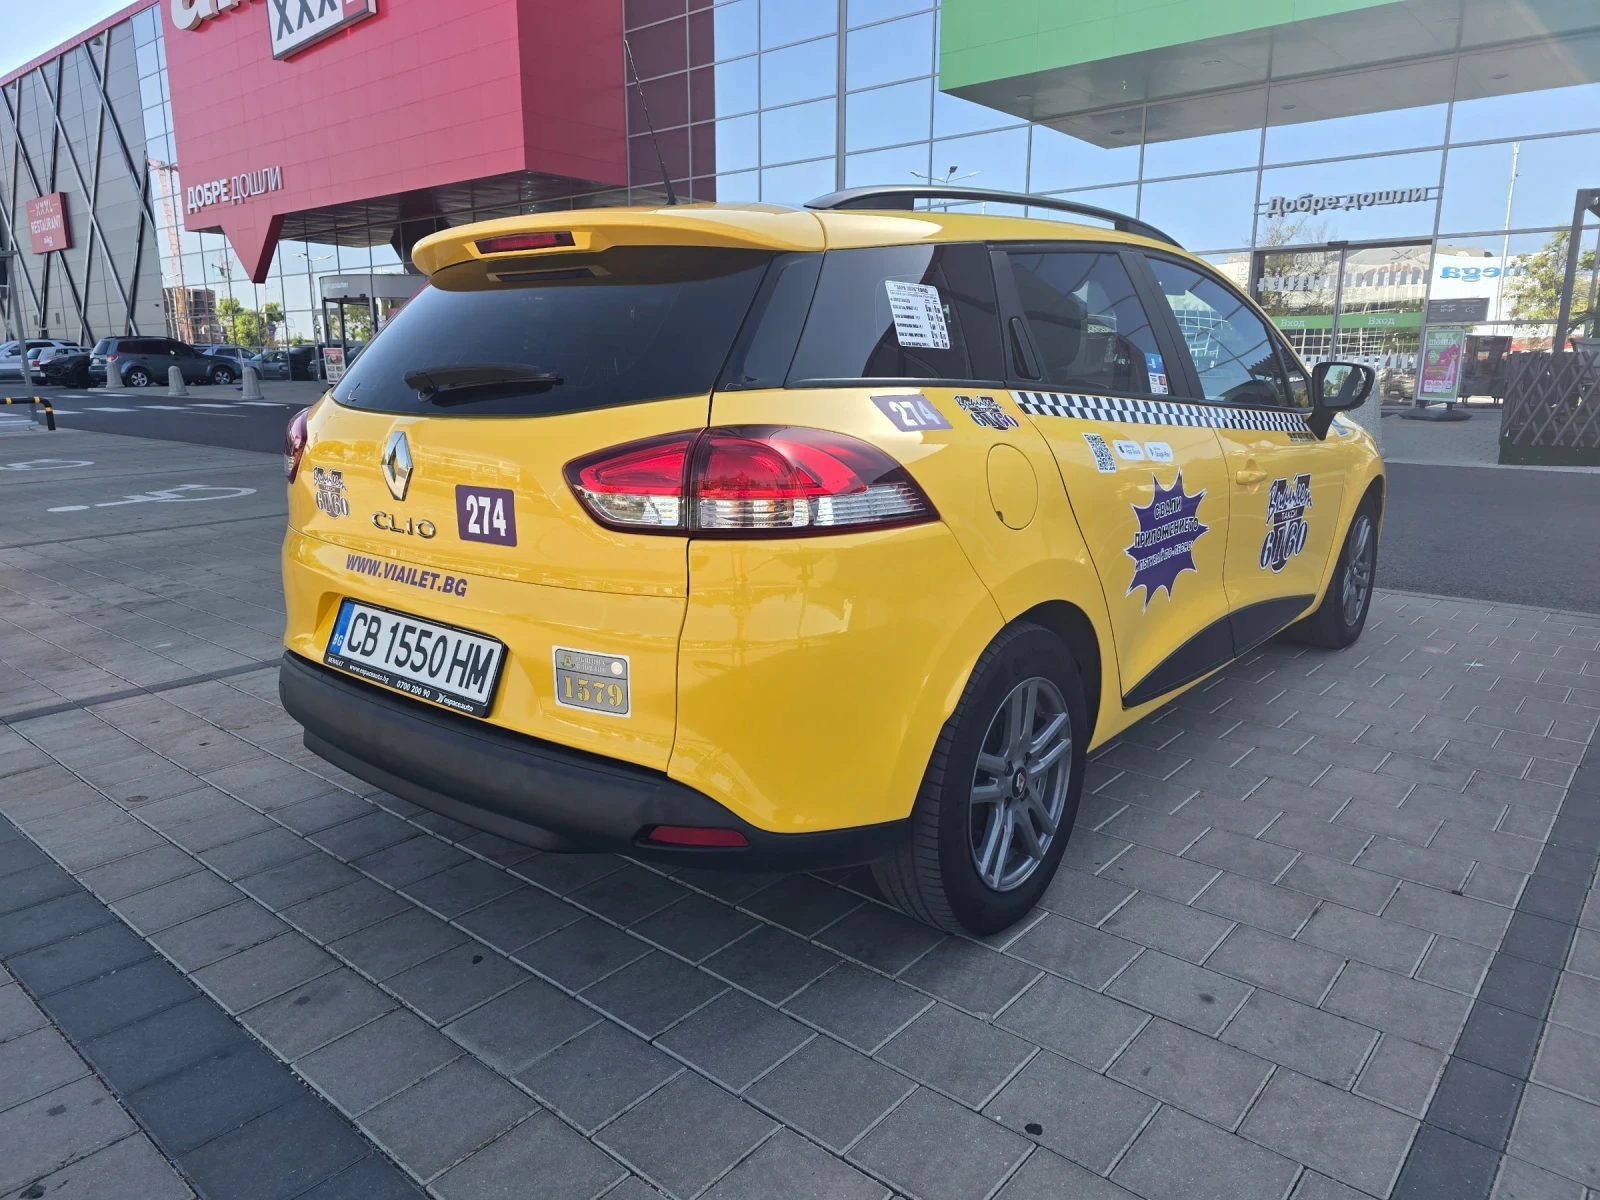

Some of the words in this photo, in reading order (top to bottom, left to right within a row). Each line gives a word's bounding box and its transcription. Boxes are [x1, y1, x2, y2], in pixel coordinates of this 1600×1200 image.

[187, 178, 231, 214] ДОБРЕ
[231, 166, 282, 205] ДОШЛИ
[1265, 193, 1340, 218] Добре
[1342, 187, 1428, 211] дошли
[30, 214, 61, 234] RESTAURANT
[1280, 318, 1305, 328] Вход
[1367, 316, 1395, 326] Вход
[888, 401, 941, 426] 274
[466, 494, 507, 537] 274
[1154, 496, 1182, 520] СВАЛИ
[371, 510, 437, 539] CLIO
[1134, 517, 1199, 548] ПРИЛОЖЕНИЕТО
[1259, 520, 1308, 570] 6160
[346, 553, 468, 597] WWW.VIAILET.BG
[332, 633, 344, 647] BG
[384, 622, 448, 679] 1550
[445, 639, 495, 694] HM
[349, 664, 390, 685] www.espaceauto.bg
[396, 680, 411, 691] 0700
[410, 684, 422, 695] 200
[422, 689, 431, 698] 90
[443, 697, 474, 712] espaceauto
[564, 676, 623, 708] 1579
